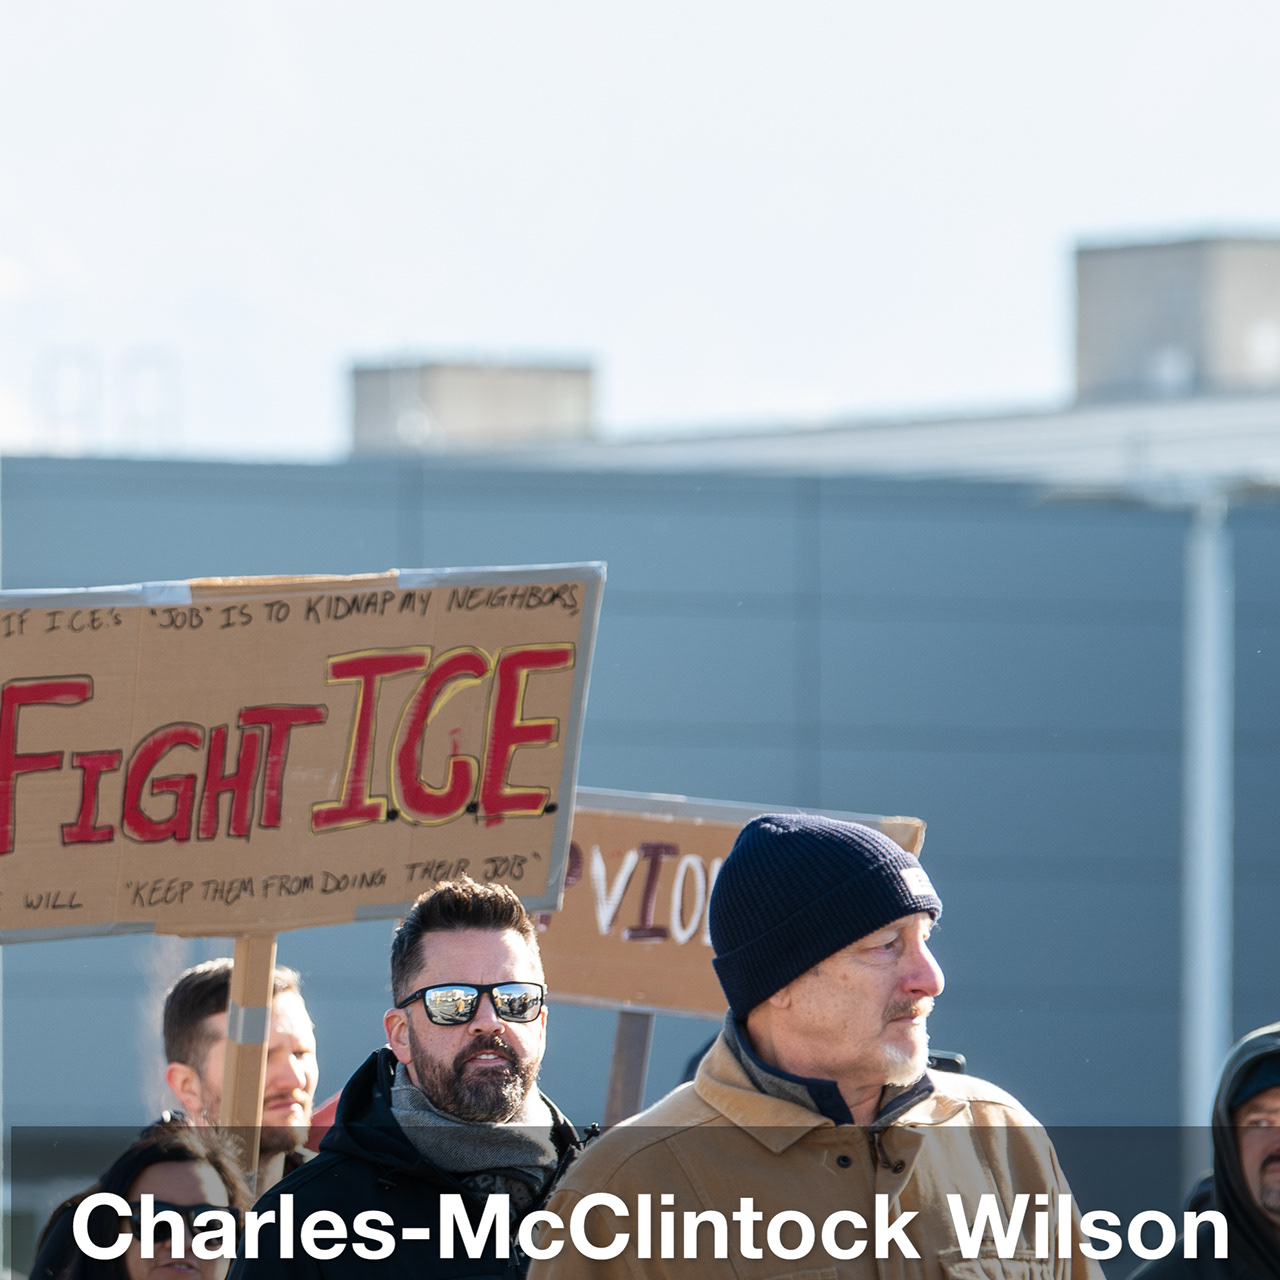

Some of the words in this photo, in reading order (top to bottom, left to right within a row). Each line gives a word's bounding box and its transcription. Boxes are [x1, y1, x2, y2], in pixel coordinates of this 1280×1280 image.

[1, 608, 31, 638] IF
[149, 605, 212, 630] "JOB"
[219, 604, 253, 630] IS
[264, 600, 290, 623] TO
[304, 590, 394, 625] KIDNAP
[398, 589, 432, 617] MY
[23, 890, 84, 911] WILL
[201, 876, 255, 906] THEM
[261, 873, 314, 899] FROM
[320, 868, 388, 895] DOING
[405, 857, 471, 883] THEIR
